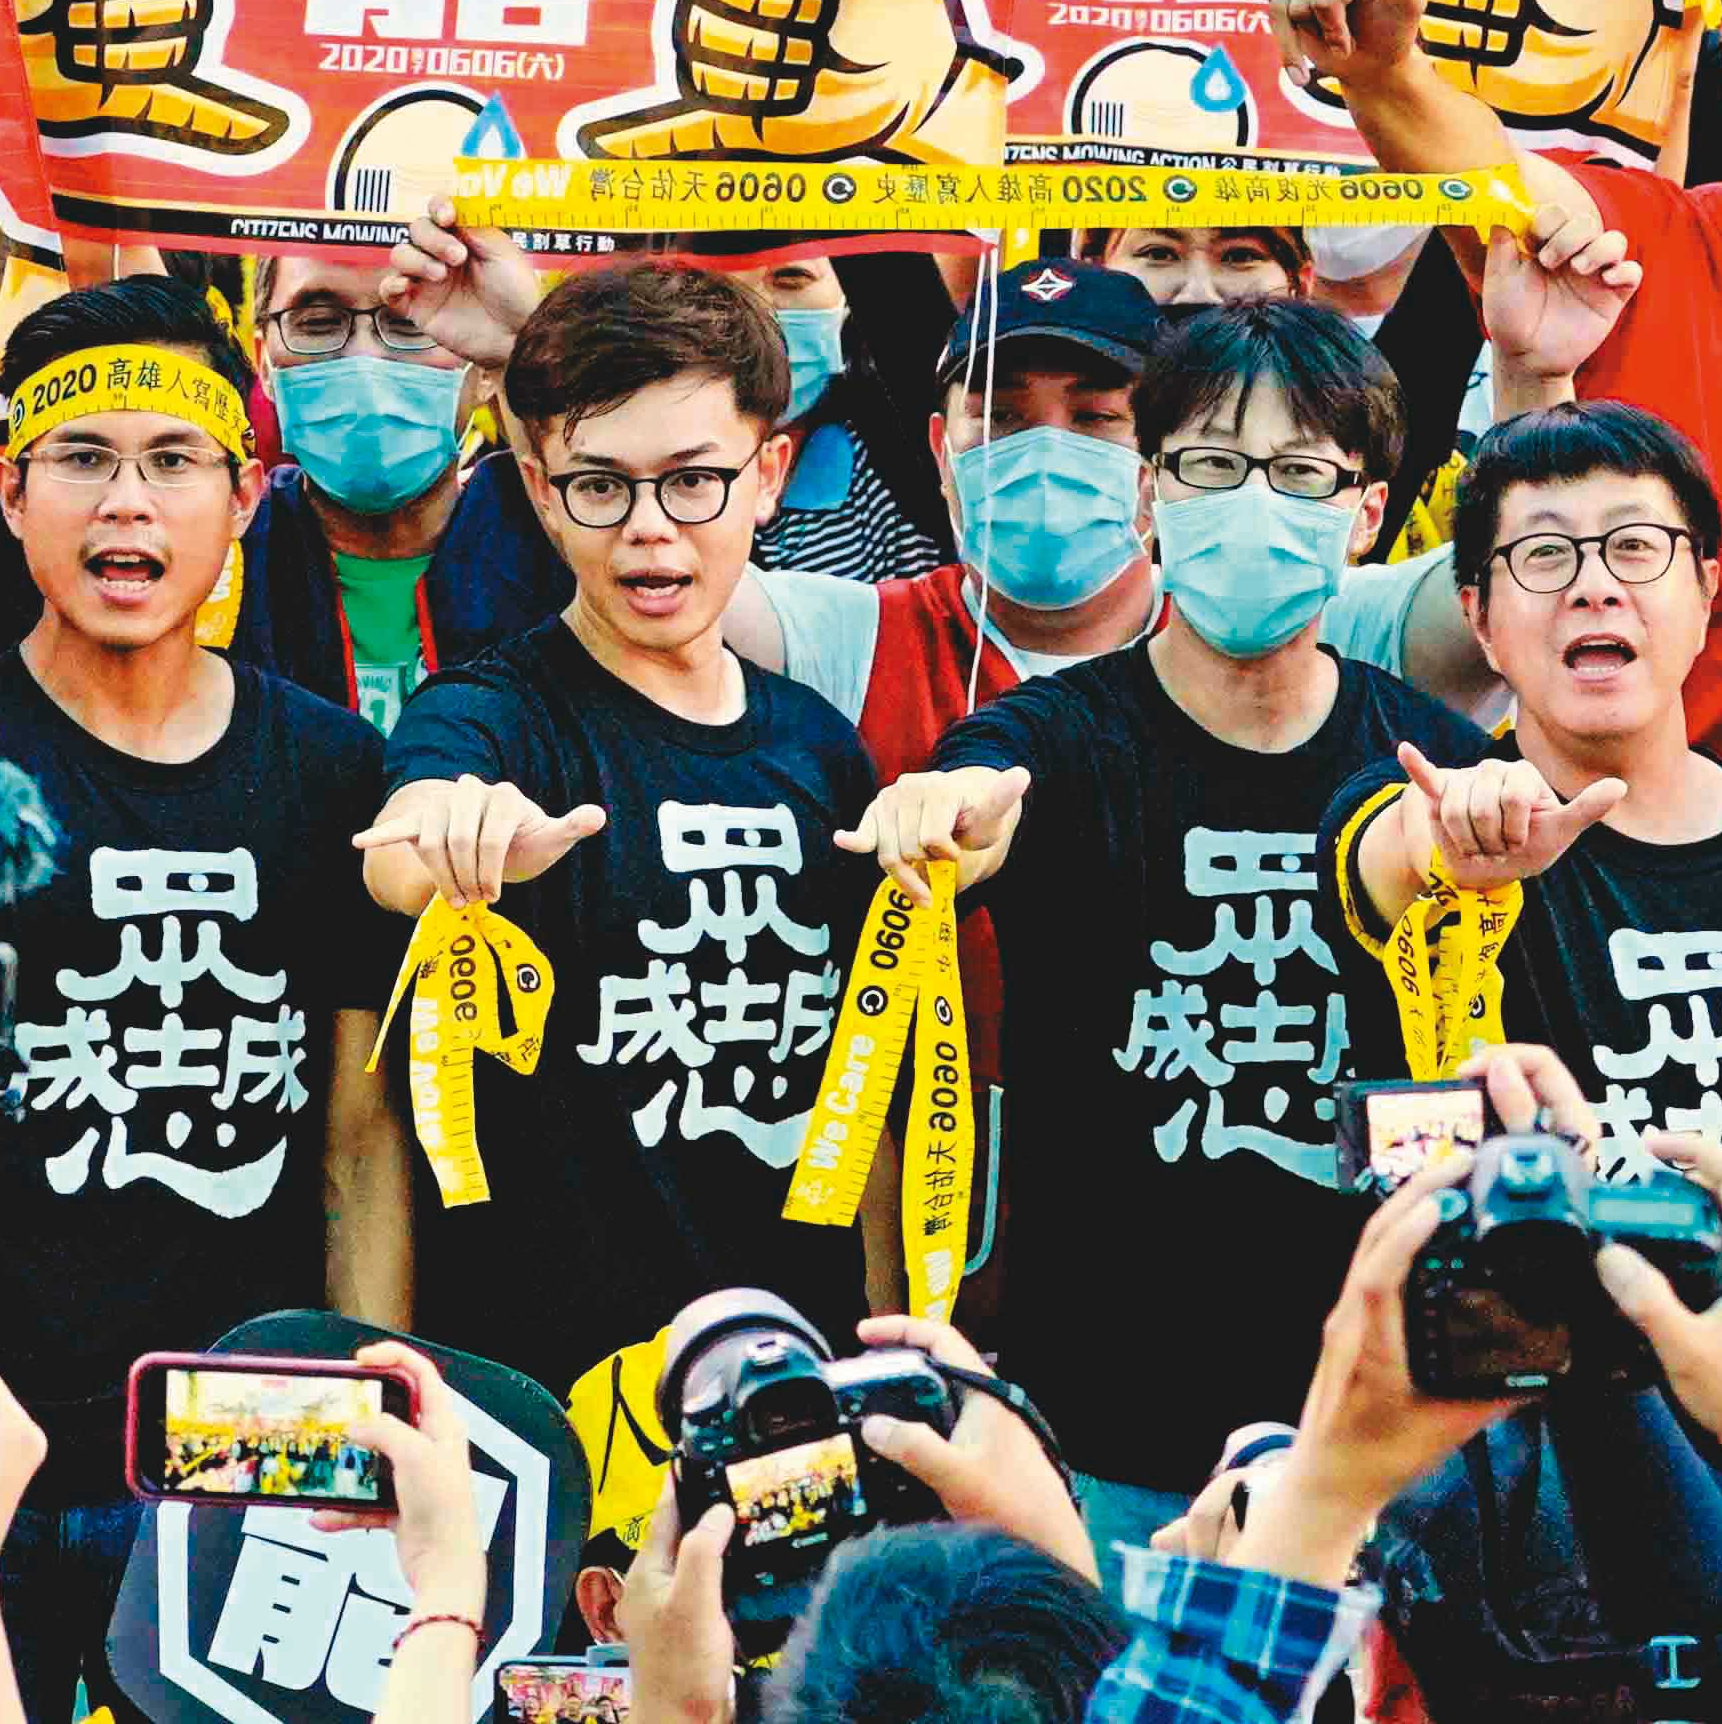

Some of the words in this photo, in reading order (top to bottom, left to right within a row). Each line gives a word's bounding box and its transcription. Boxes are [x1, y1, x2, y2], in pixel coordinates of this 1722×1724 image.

[31, 362, 99, 415] 2020
[870, 888, 918, 971] 0606
[1398, 915, 1420, 996] 0606
[826, 1034, 876, 1114] Care
[805, 1120, 848, 1170] We
